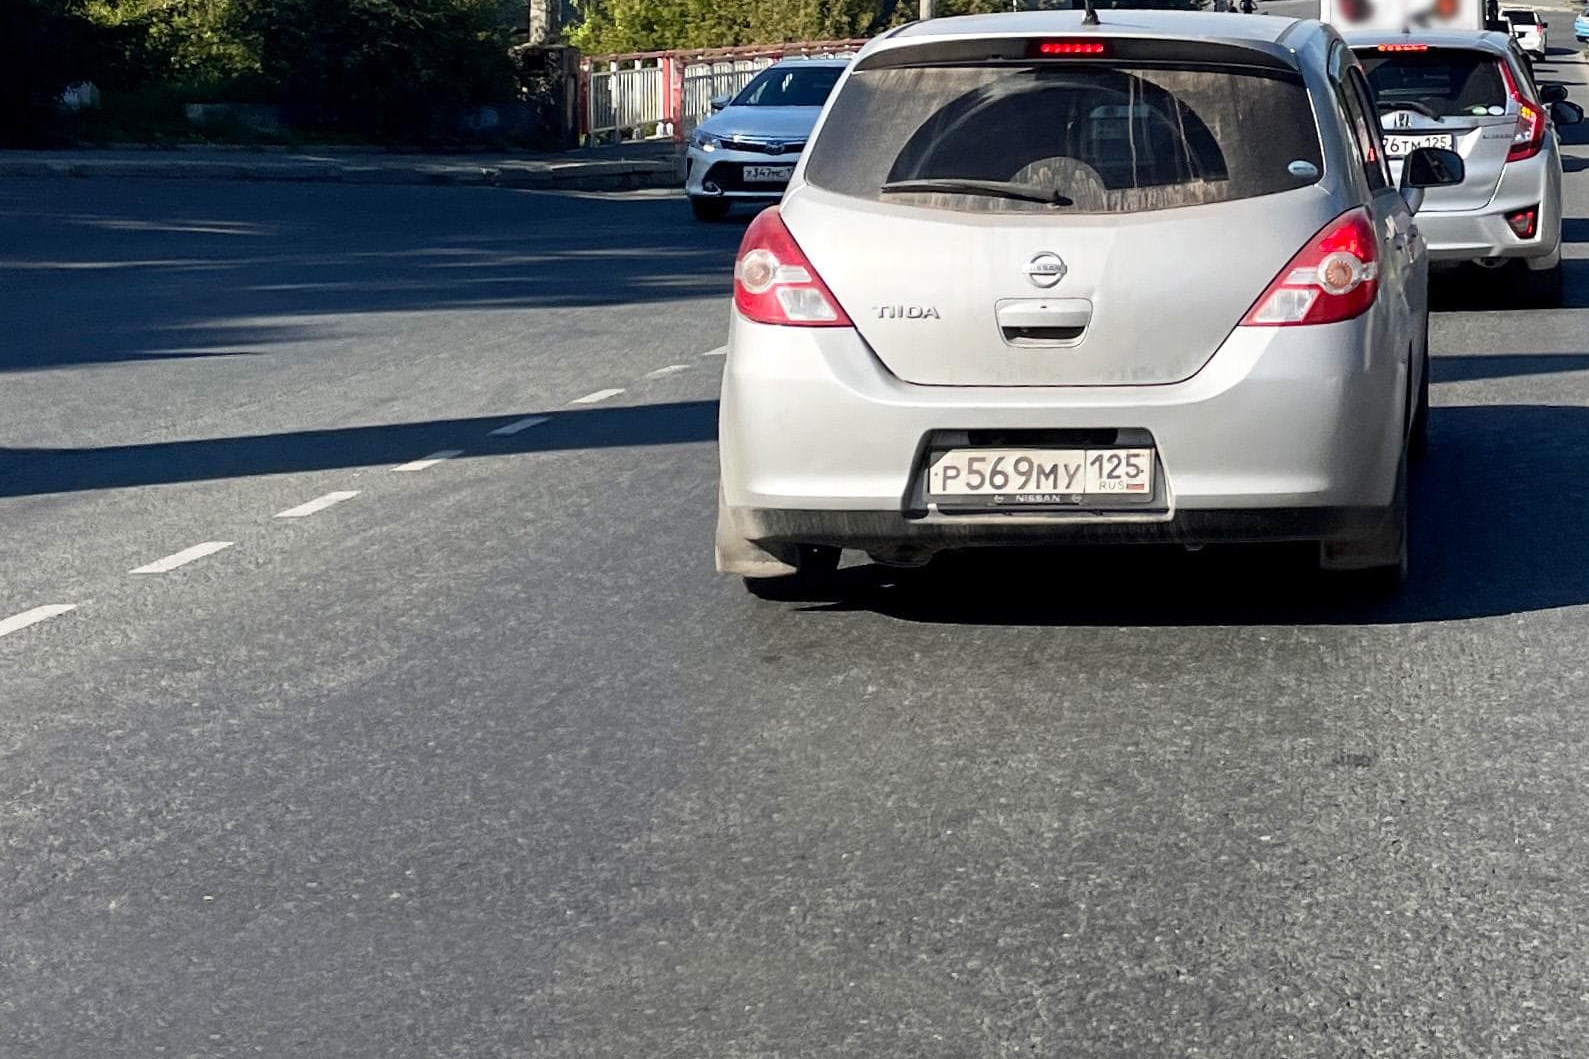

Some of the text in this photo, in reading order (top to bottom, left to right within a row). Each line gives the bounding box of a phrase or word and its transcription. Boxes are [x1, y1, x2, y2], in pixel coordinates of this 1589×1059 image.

[872, 305, 941, 319] TIIDA
[1090, 453, 1141, 480] 125
[1099, 480, 1125, 491] RUS
[1016, 494, 1061, 502] NISSAN
